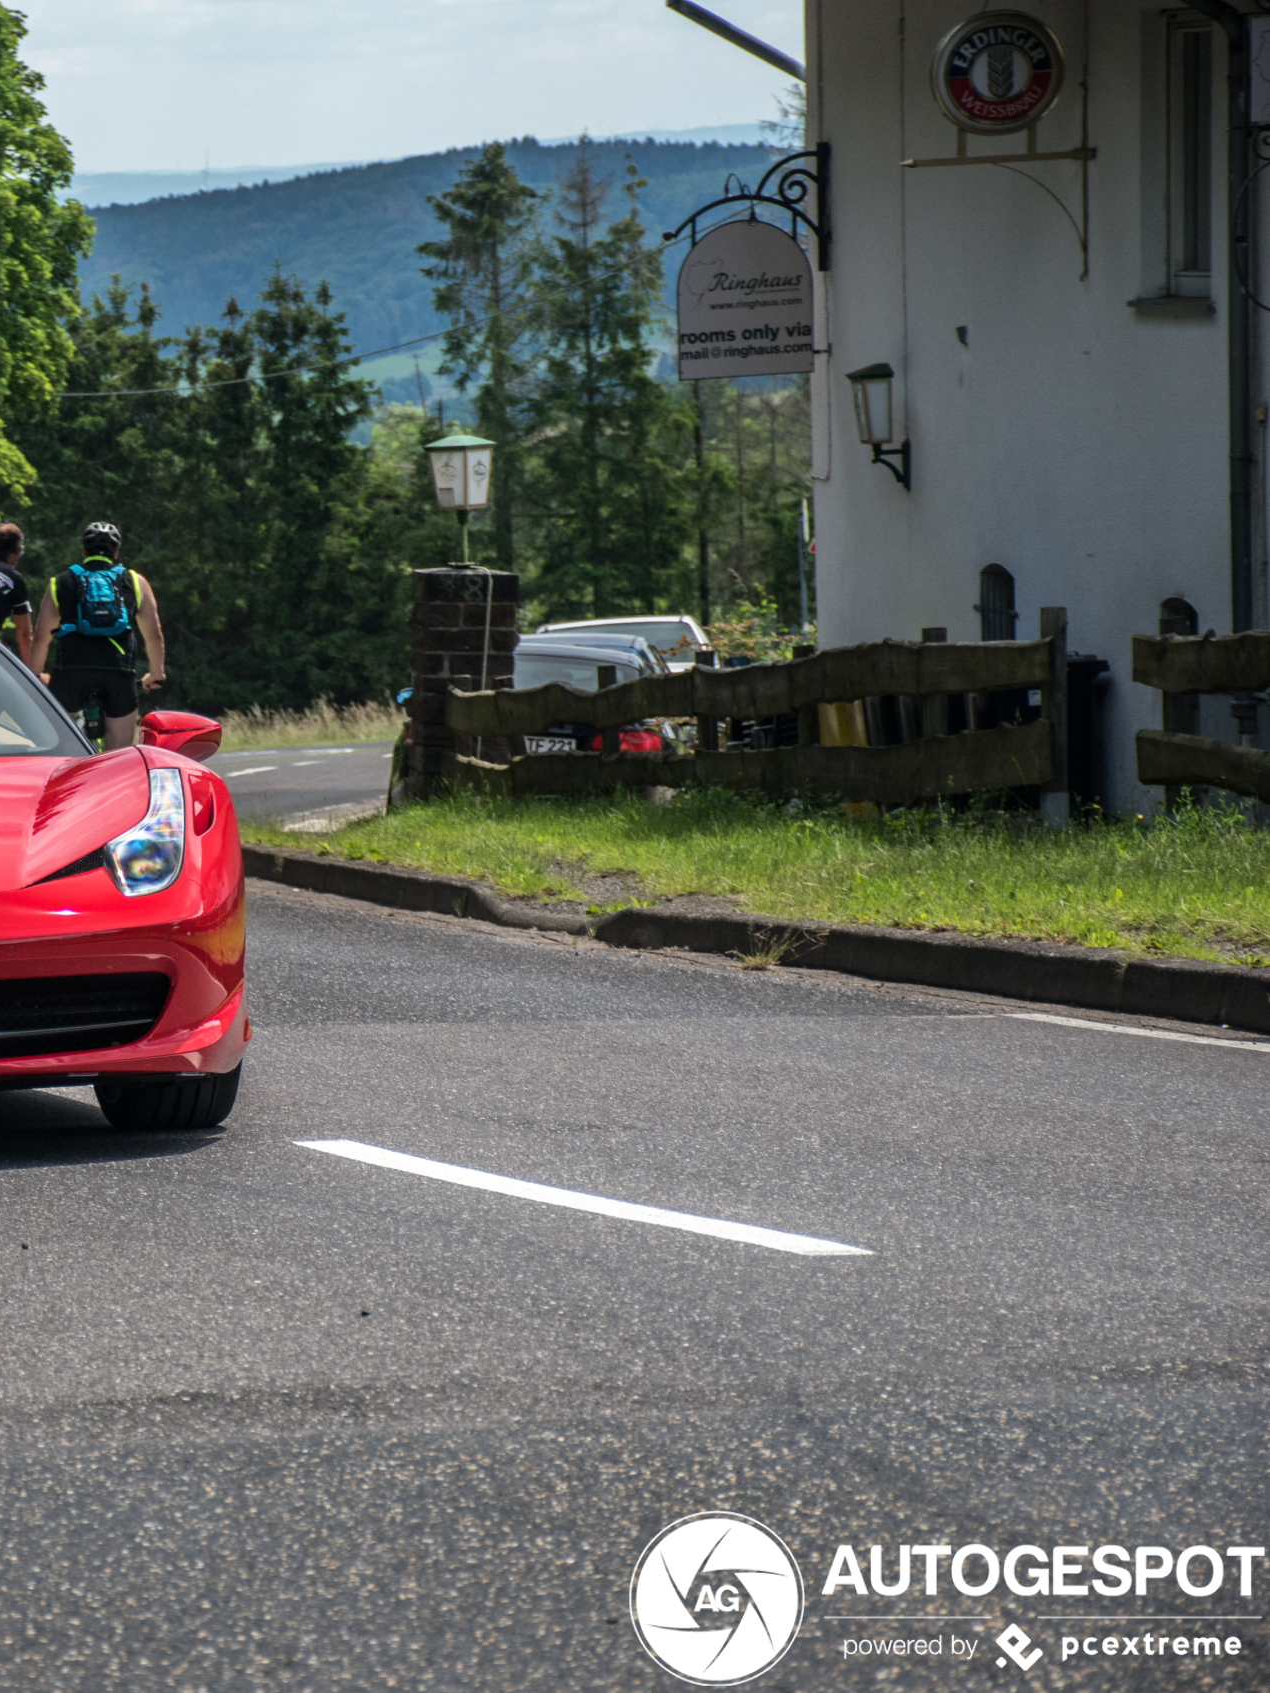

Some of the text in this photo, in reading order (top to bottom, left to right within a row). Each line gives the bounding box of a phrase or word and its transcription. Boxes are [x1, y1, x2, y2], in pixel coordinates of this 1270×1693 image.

[952, 27, 1046, 68] ERDINGER
[708, 272, 803, 296] Ringhaus
[710, 298, 803, 311] www.ringhaus.com
[680, 322, 812, 345] rooms only via
